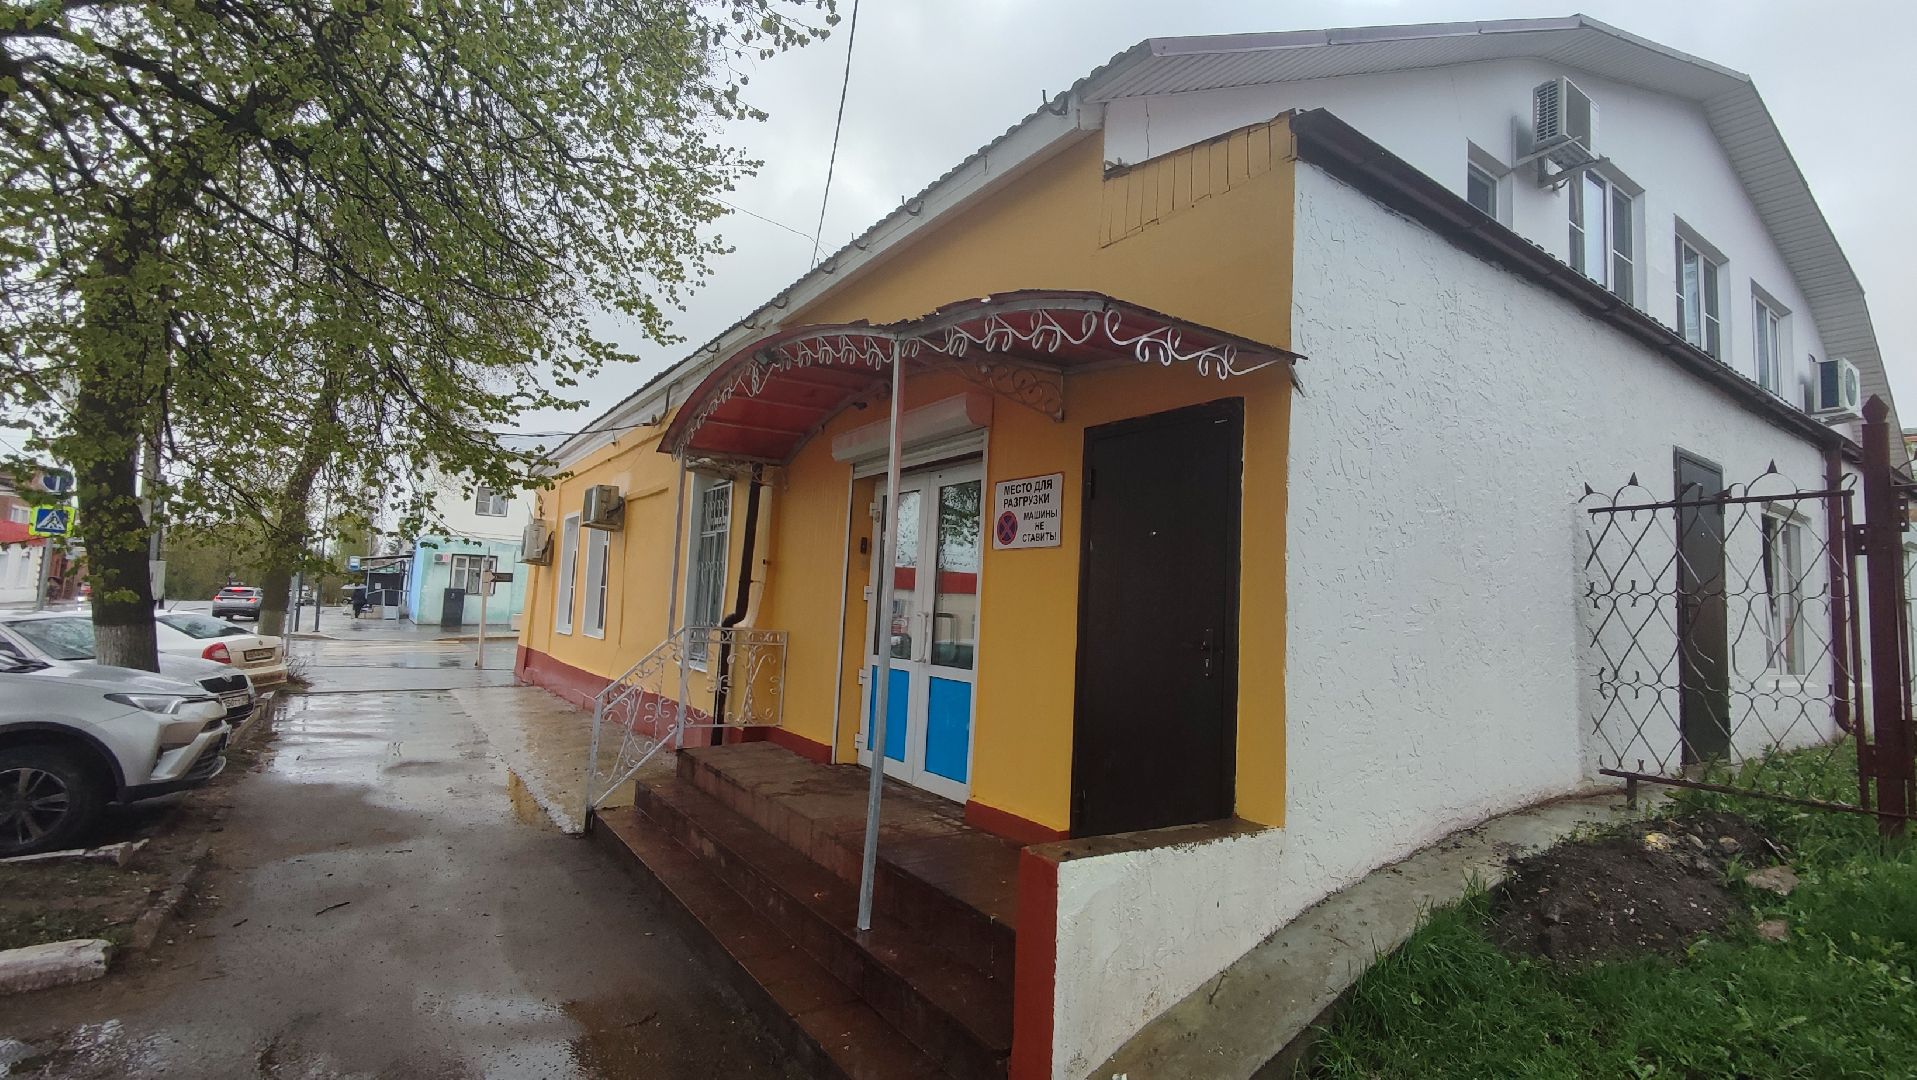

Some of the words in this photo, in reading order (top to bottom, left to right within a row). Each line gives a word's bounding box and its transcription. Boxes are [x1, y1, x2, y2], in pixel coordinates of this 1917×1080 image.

[1003, 483, 1032, 496] МЕСТО
[1034, 479, 1053, 493] ДЛЯ
[1003, 493, 1050, 509] РАЗГРУЗКИ
[1023, 509, 1058, 520] МАШИНЫ
[1034, 521, 1044, 531] НЕ
